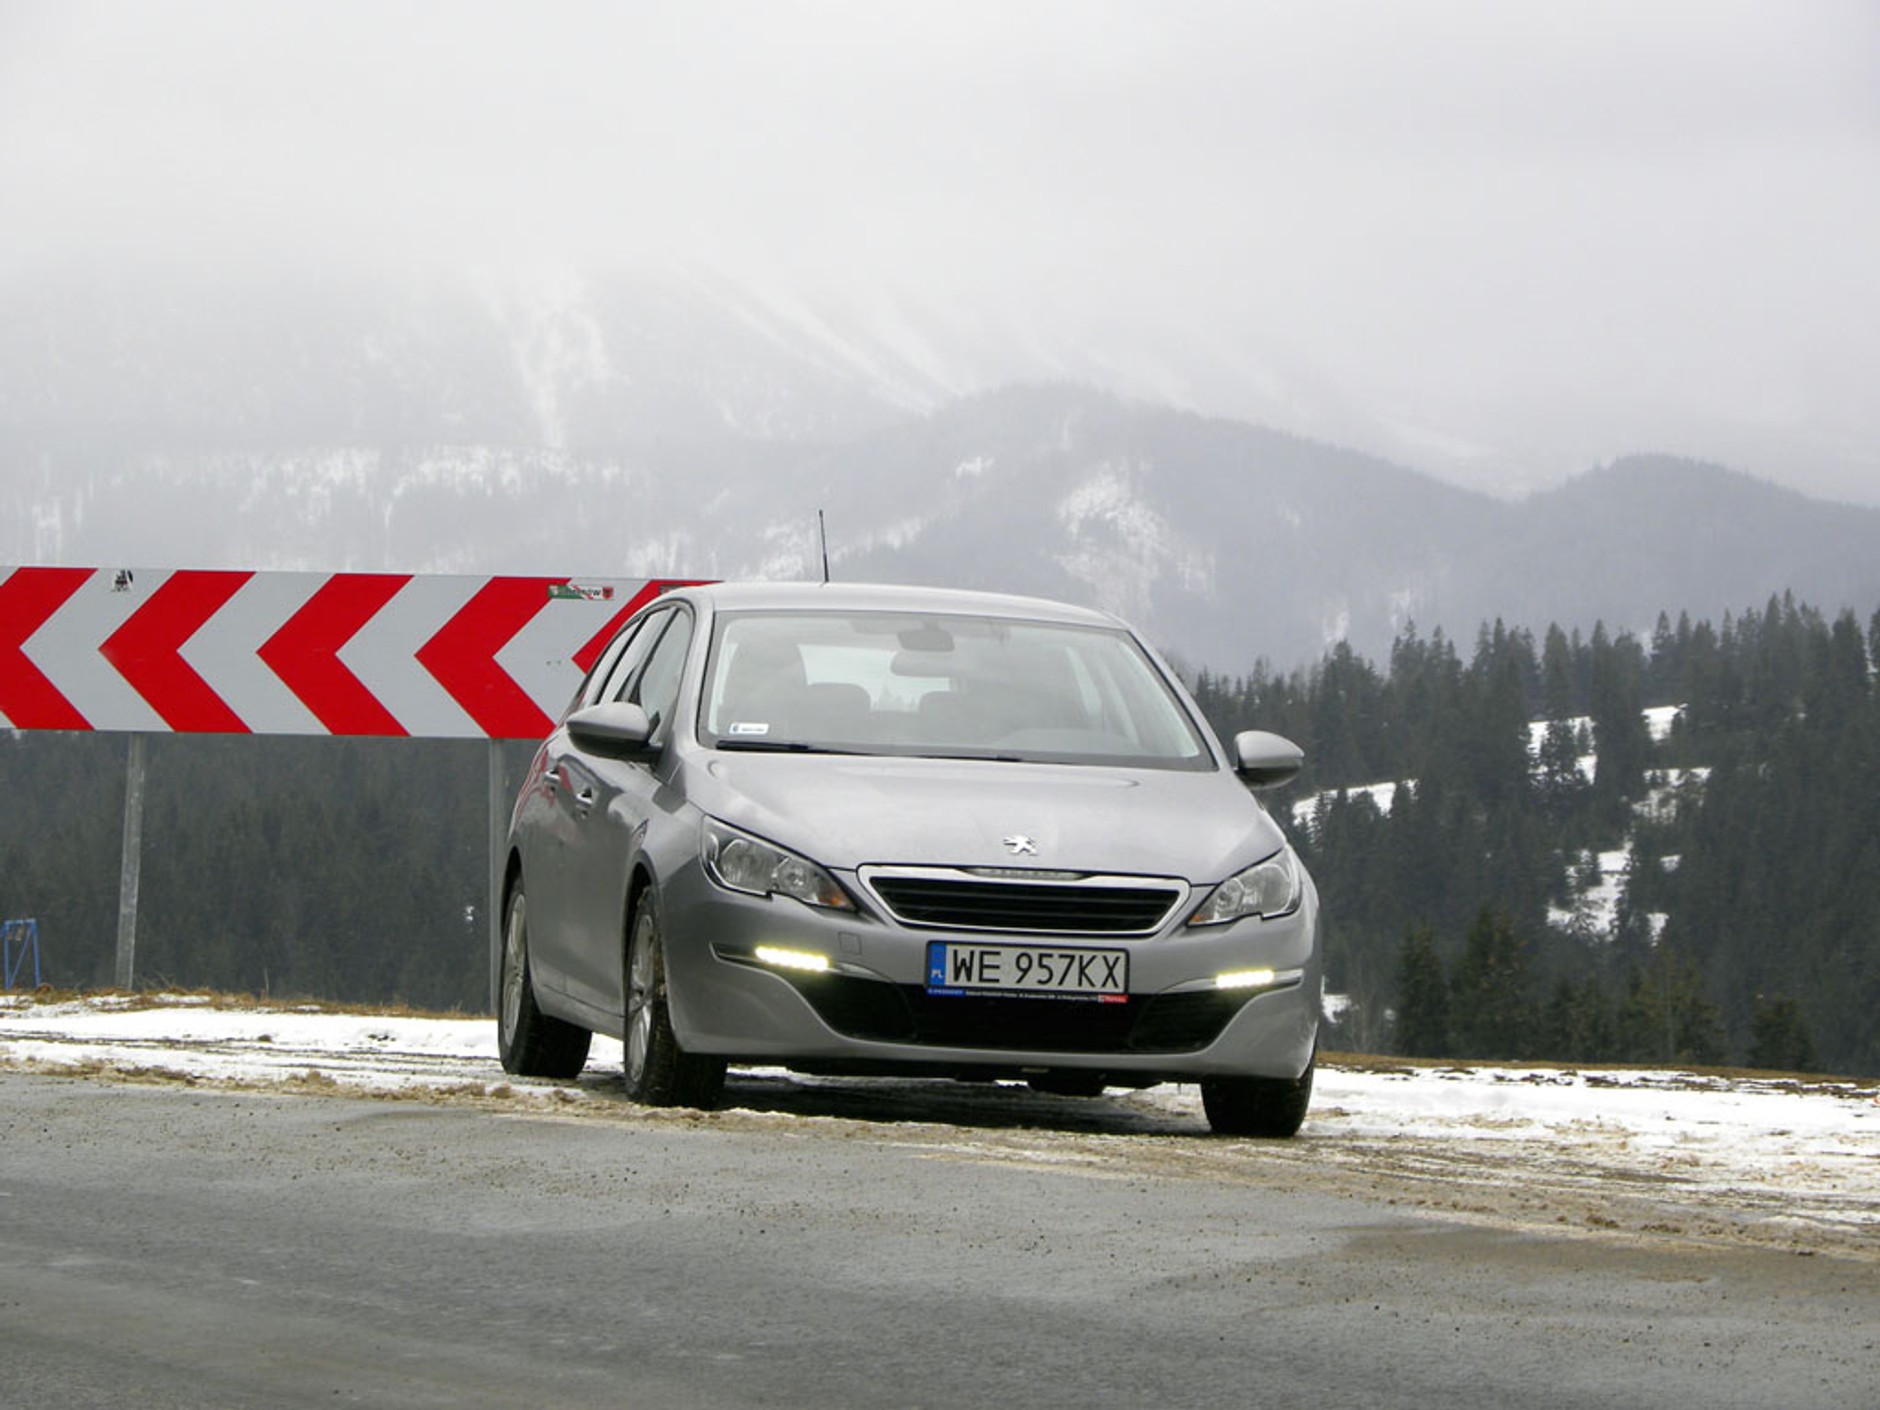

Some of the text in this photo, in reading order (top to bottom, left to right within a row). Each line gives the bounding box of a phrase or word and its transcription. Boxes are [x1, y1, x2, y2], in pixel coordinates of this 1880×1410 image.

[931, 969, 944, 979] PL
[953, 949, 1120, 988] WE 957KX
